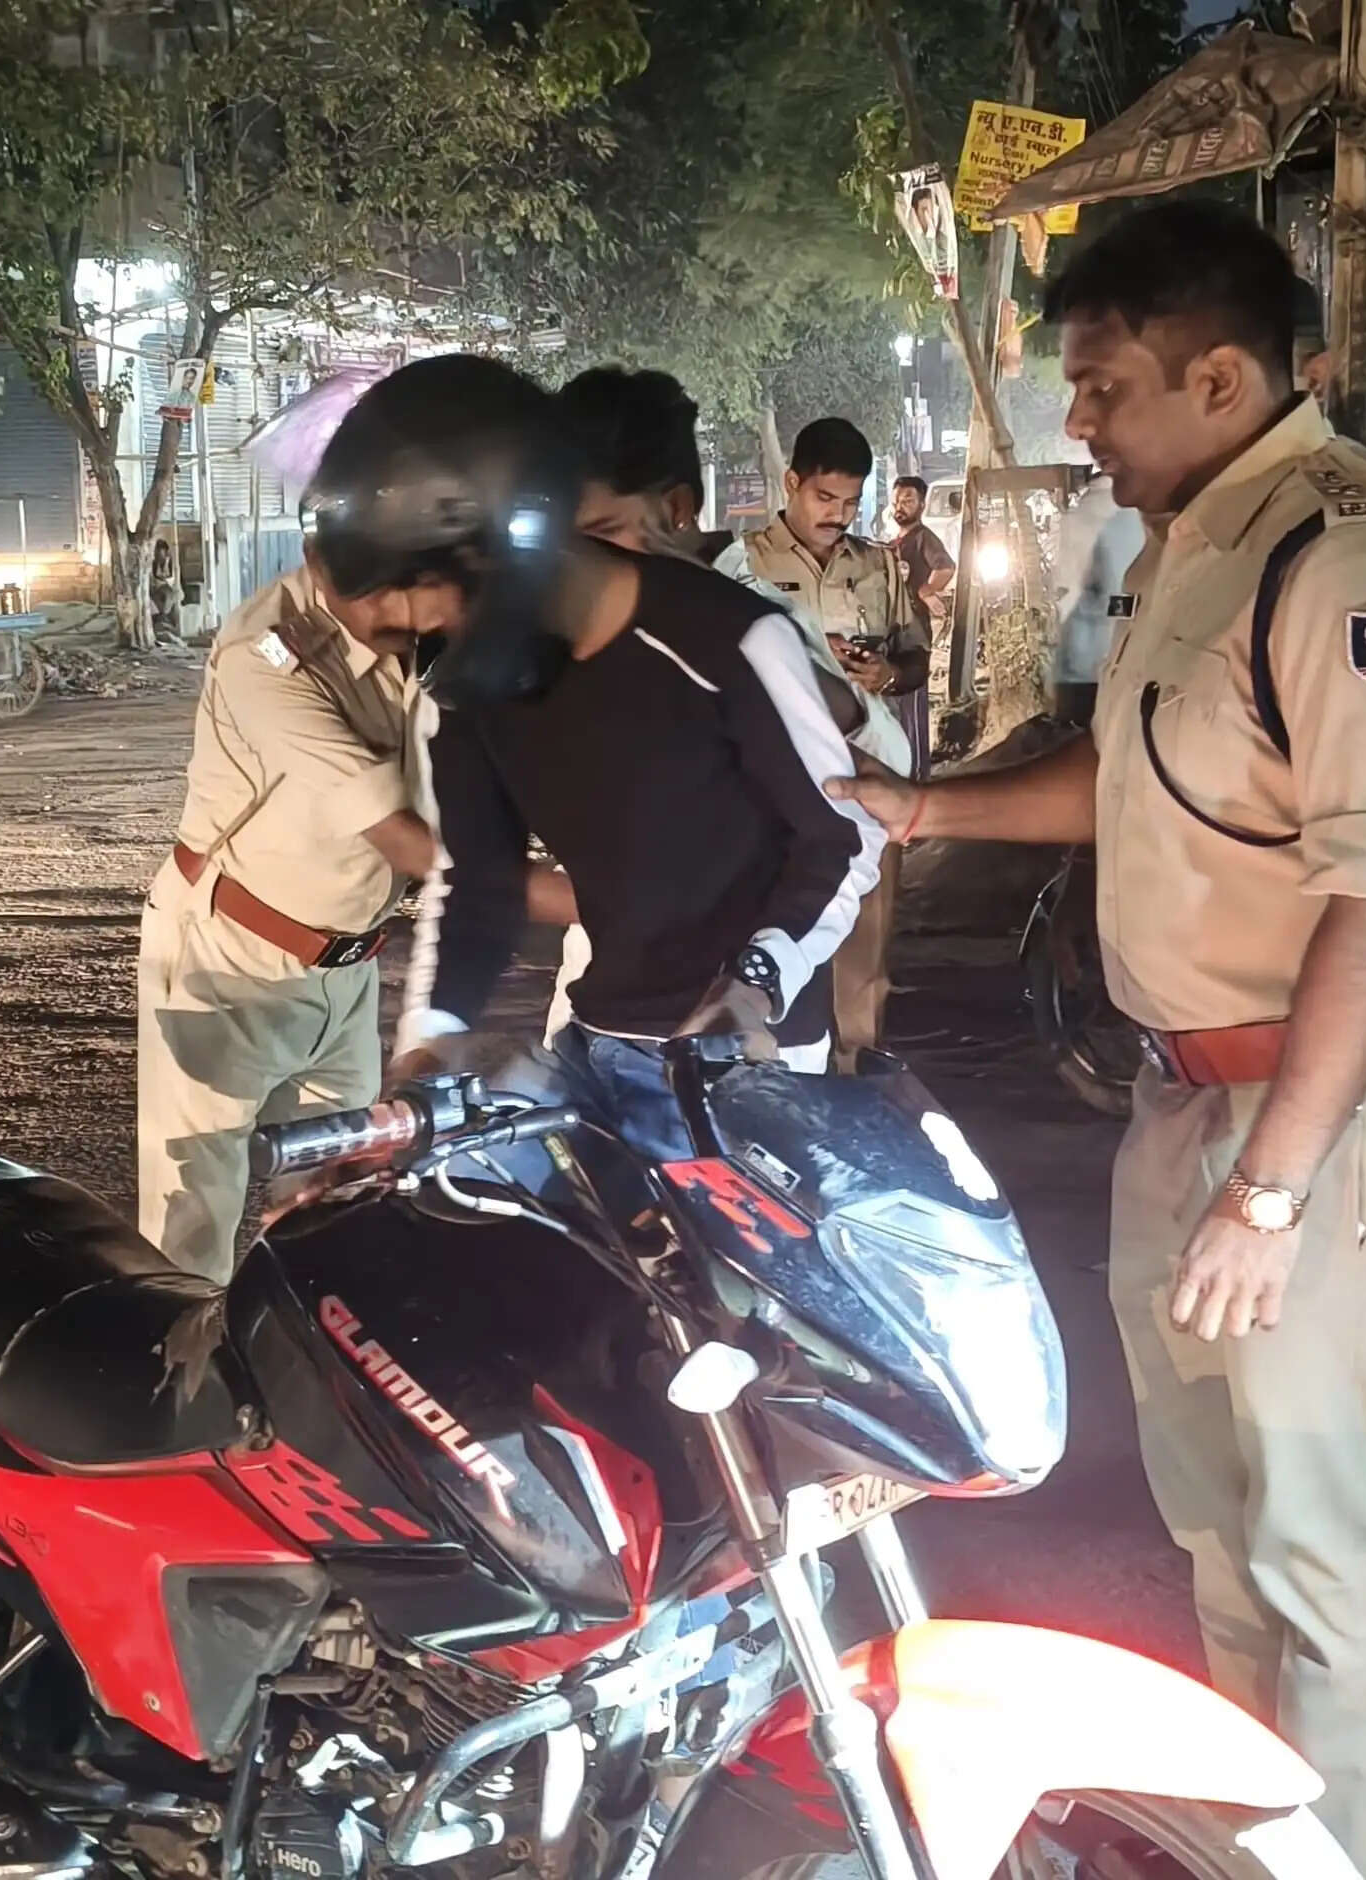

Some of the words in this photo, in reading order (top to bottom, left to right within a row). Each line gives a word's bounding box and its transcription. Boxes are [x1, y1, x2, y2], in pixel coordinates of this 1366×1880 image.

[970, 151, 1026, 173] Nursery
[318, 1295, 516, 1527] GLAMOUR
[277, 1847, 321, 1877] Hero
